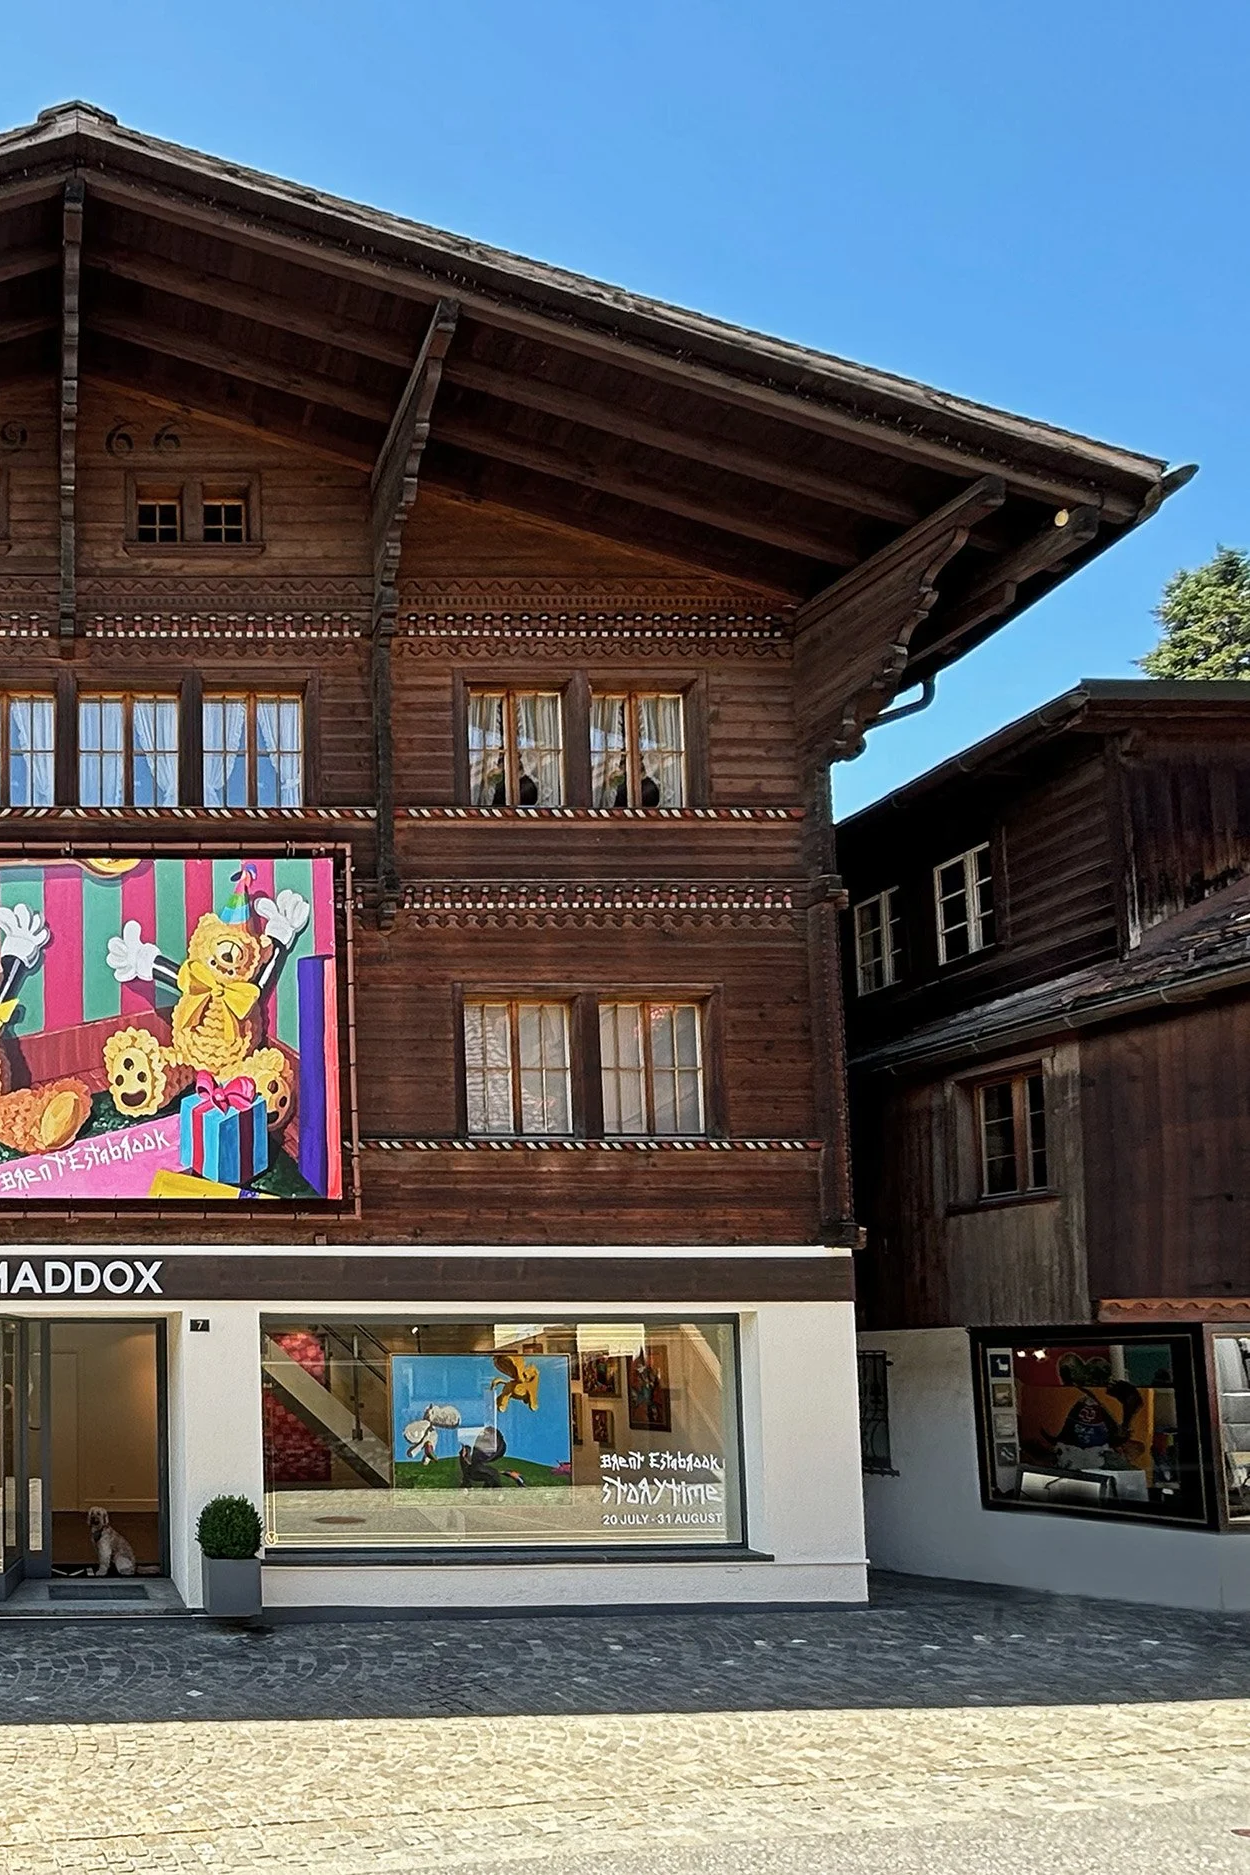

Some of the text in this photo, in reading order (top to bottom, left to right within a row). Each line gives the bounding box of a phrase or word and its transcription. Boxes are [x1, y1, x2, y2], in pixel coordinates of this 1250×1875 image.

[196, 1320, 203, 1330] 7
[603, 1514, 618, 1525] 20
[620, 1514, 649, 1525] JULY
[657, 1513, 671, 1525] 31
[674, 1512, 724, 1525] AUGUST
